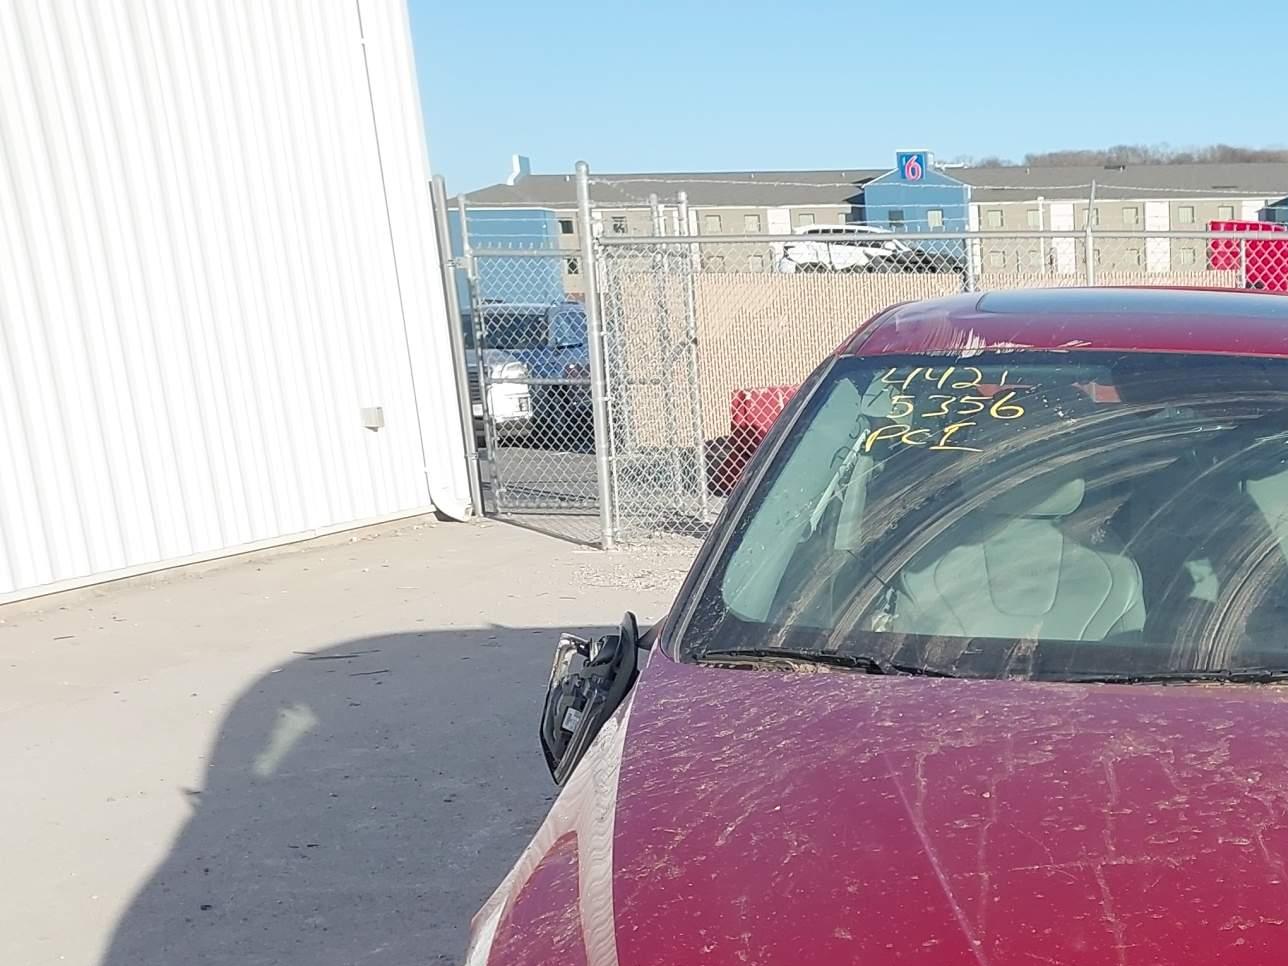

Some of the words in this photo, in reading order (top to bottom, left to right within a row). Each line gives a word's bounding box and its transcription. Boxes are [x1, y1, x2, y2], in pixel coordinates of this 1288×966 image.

[905, 154, 921, 180] 6
[881, 366, 1008, 390] 4421
[886, 391, 1024, 419] 5356
